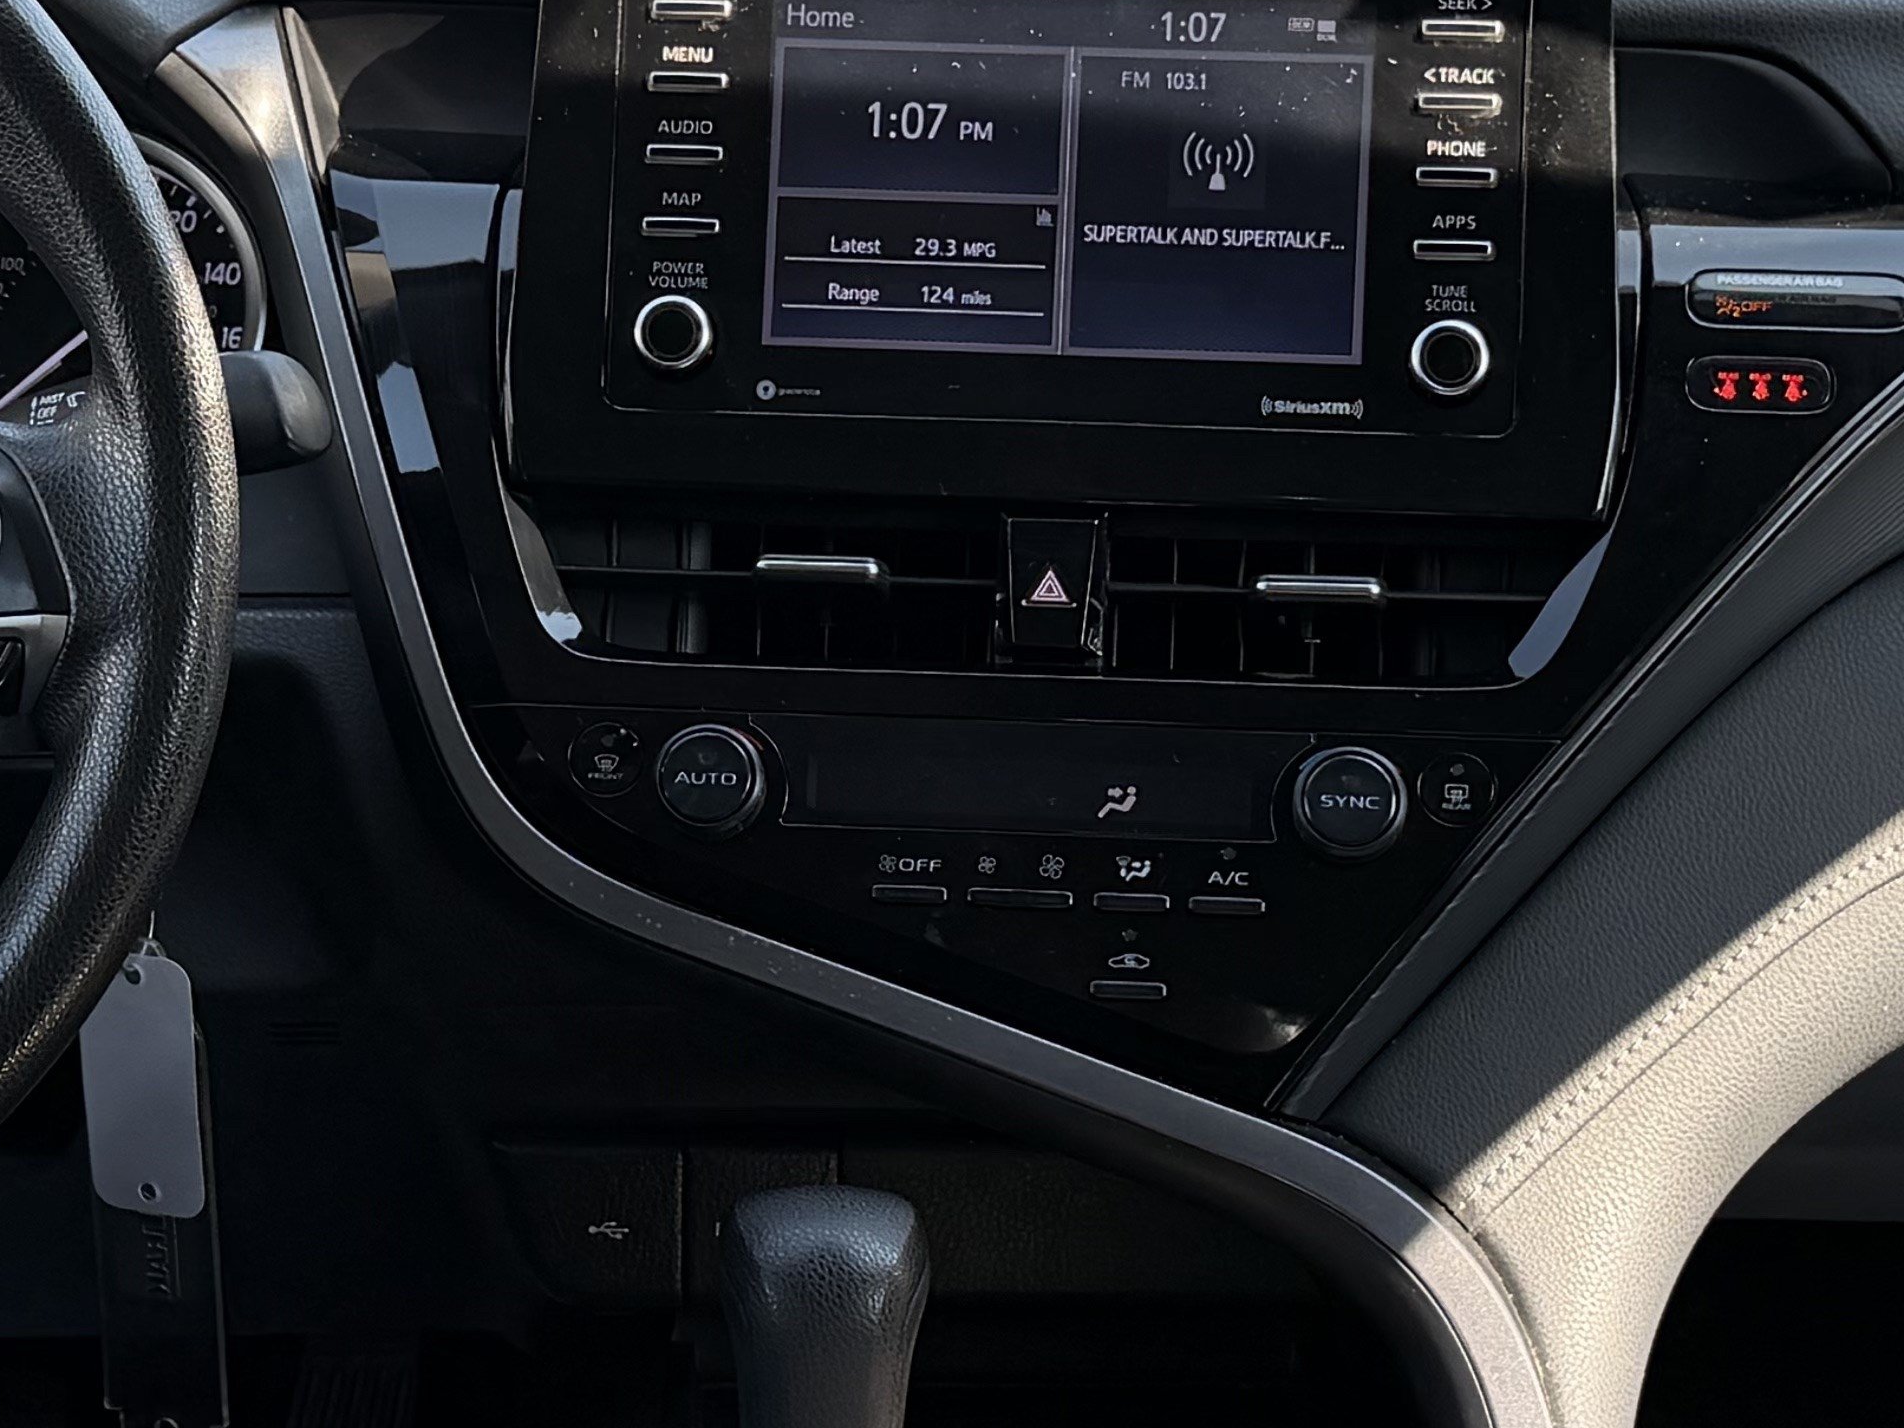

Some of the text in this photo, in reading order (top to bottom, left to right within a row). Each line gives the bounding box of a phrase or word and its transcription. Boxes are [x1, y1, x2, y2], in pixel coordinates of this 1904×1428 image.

[786, 3, 855, 28] Home
[1161, 11, 1227, 42] 1:07
[662, 45, 714, 63] MENU
[1121, 71, 1207, 90] FM 103.1
[658, 120, 713, 135] AUDIO
[868, 101, 993, 142] 1:07 PM
[1426, 140, 1486, 157] PHONE
[662, 192, 702, 206] MAP
[1432, 215, 1477, 230] APPS
[1084, 224, 1178, 248] SUPERTALK
[1181, 227, 1218, 248] AND
[830, 235, 996, 258] Latest 29.3 MPG
[1, 257, 24, 272] 100
[652, 261, 704, 275] POWER
[203, 262, 242, 286] 140
[648, 275, 709, 289] VOLUME
[828, 282, 992, 306] Range 124 miles
[1431, 285, 1468, 298] TUNE
[1424, 299, 1476, 312] SCROLL
[674, 771, 737, 786] AUTO
[1320, 794, 1381, 810] SYNC
[899, 858, 942, 872] OFF
[1208, 871, 1249, 886] A/C
